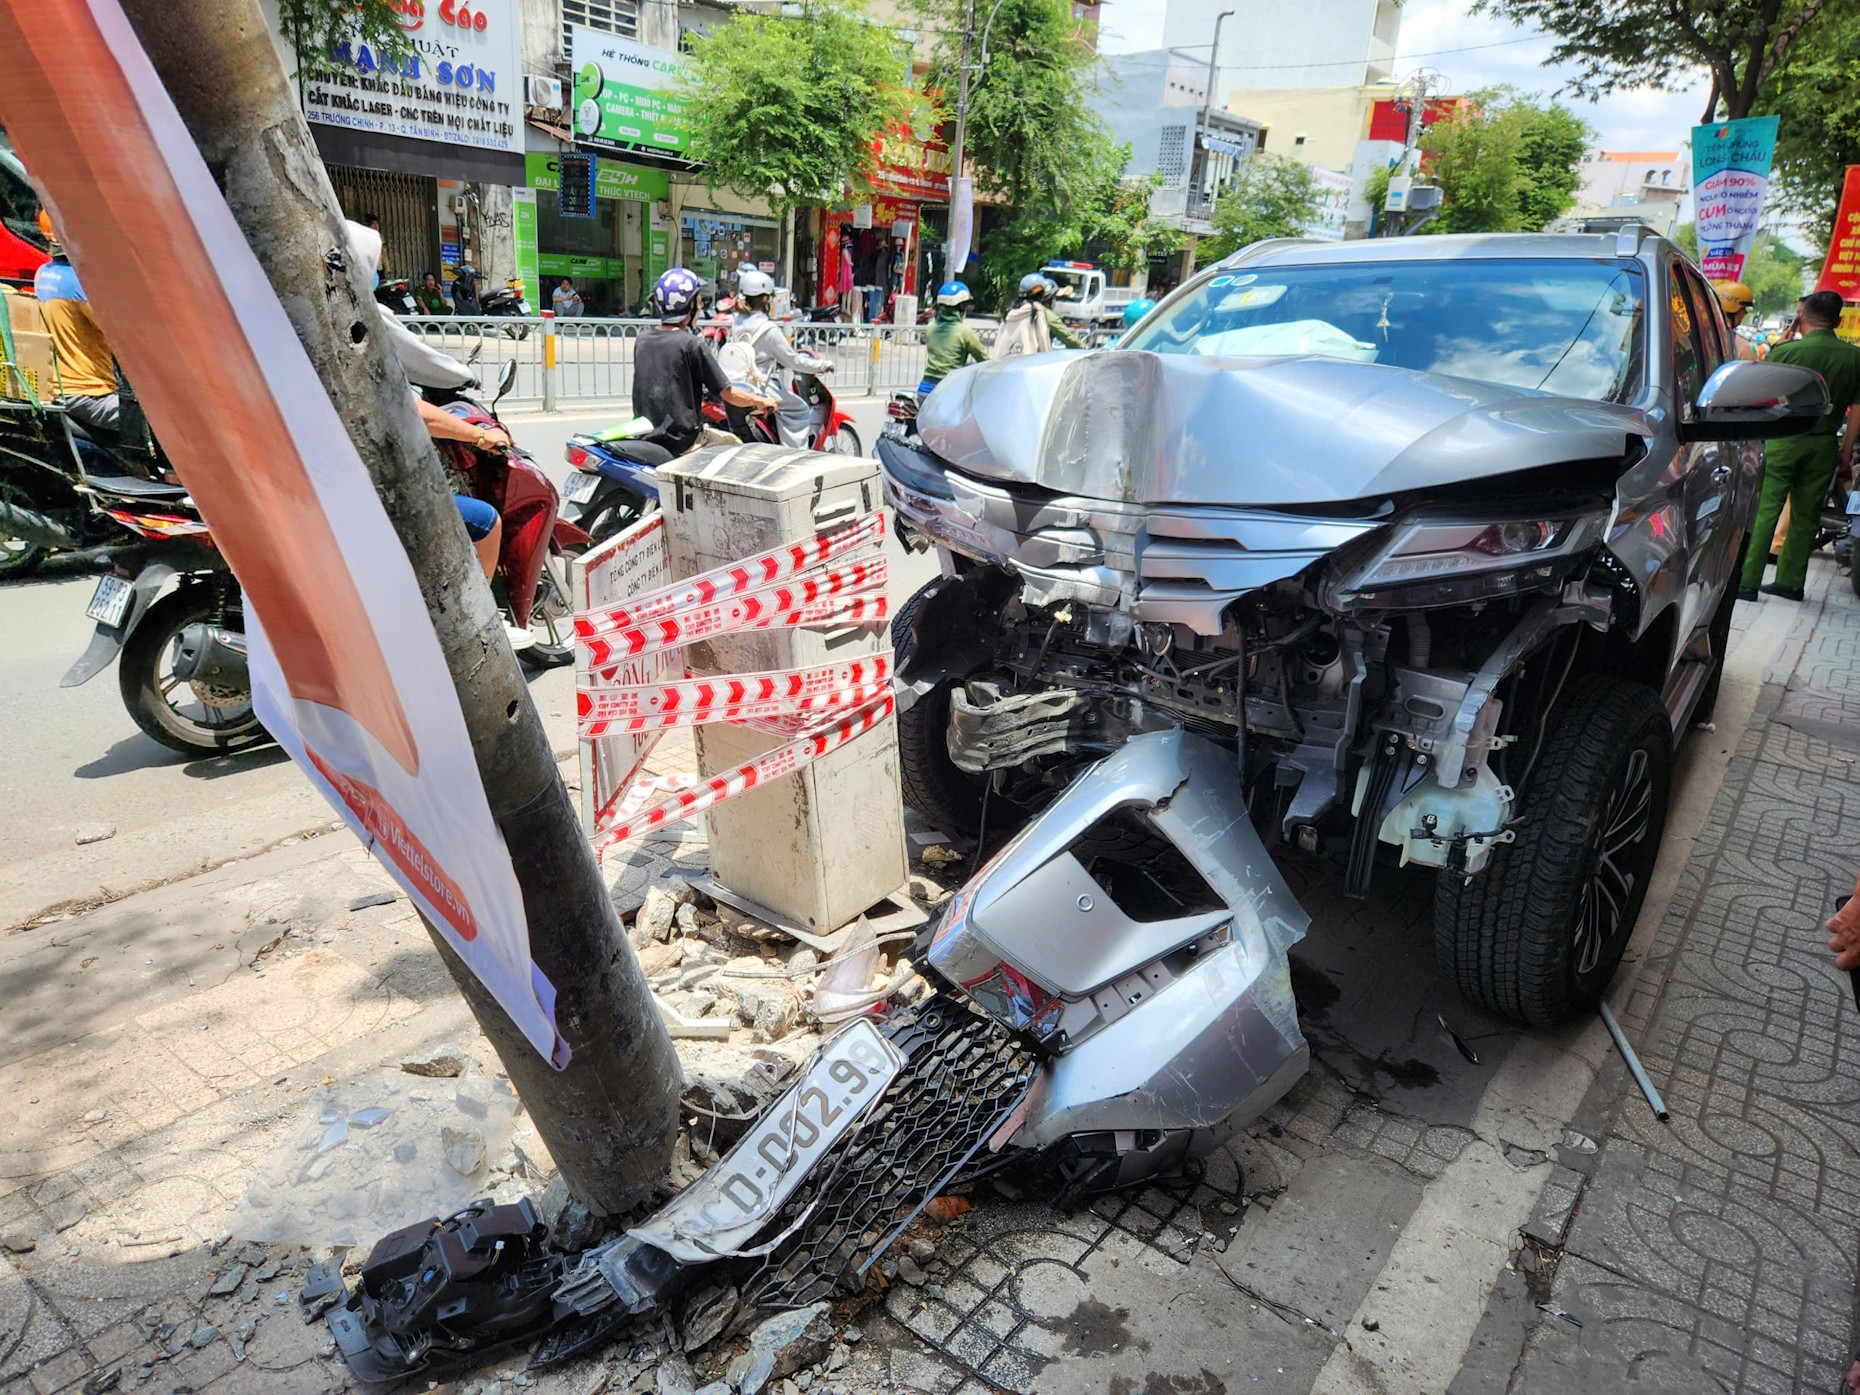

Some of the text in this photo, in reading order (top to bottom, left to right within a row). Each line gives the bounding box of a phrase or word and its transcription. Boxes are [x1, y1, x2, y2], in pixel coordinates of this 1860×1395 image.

[438, 0, 488, 32] Cáo
[436, 61, 496, 93] SƠN
[307, 110, 320, 120] 256
[497, 102, 510, 115] TY
[605, 102, 635, 118] CAMERA
[362, 99, 393, 116] LASER
[400, 106, 419, 120] CNC
[420, 109, 444, 125] TRÊN
[447, 116, 465, 131] MỌI
[493, 121, 514, 138] LIỆU
[1731, 150, 1766, 163] CHÂU
[1729, 177, 1756, 187] 90%
[624, 189, 651, 200] VTECH
[697, 1039, 888, 1227] D-002.99
